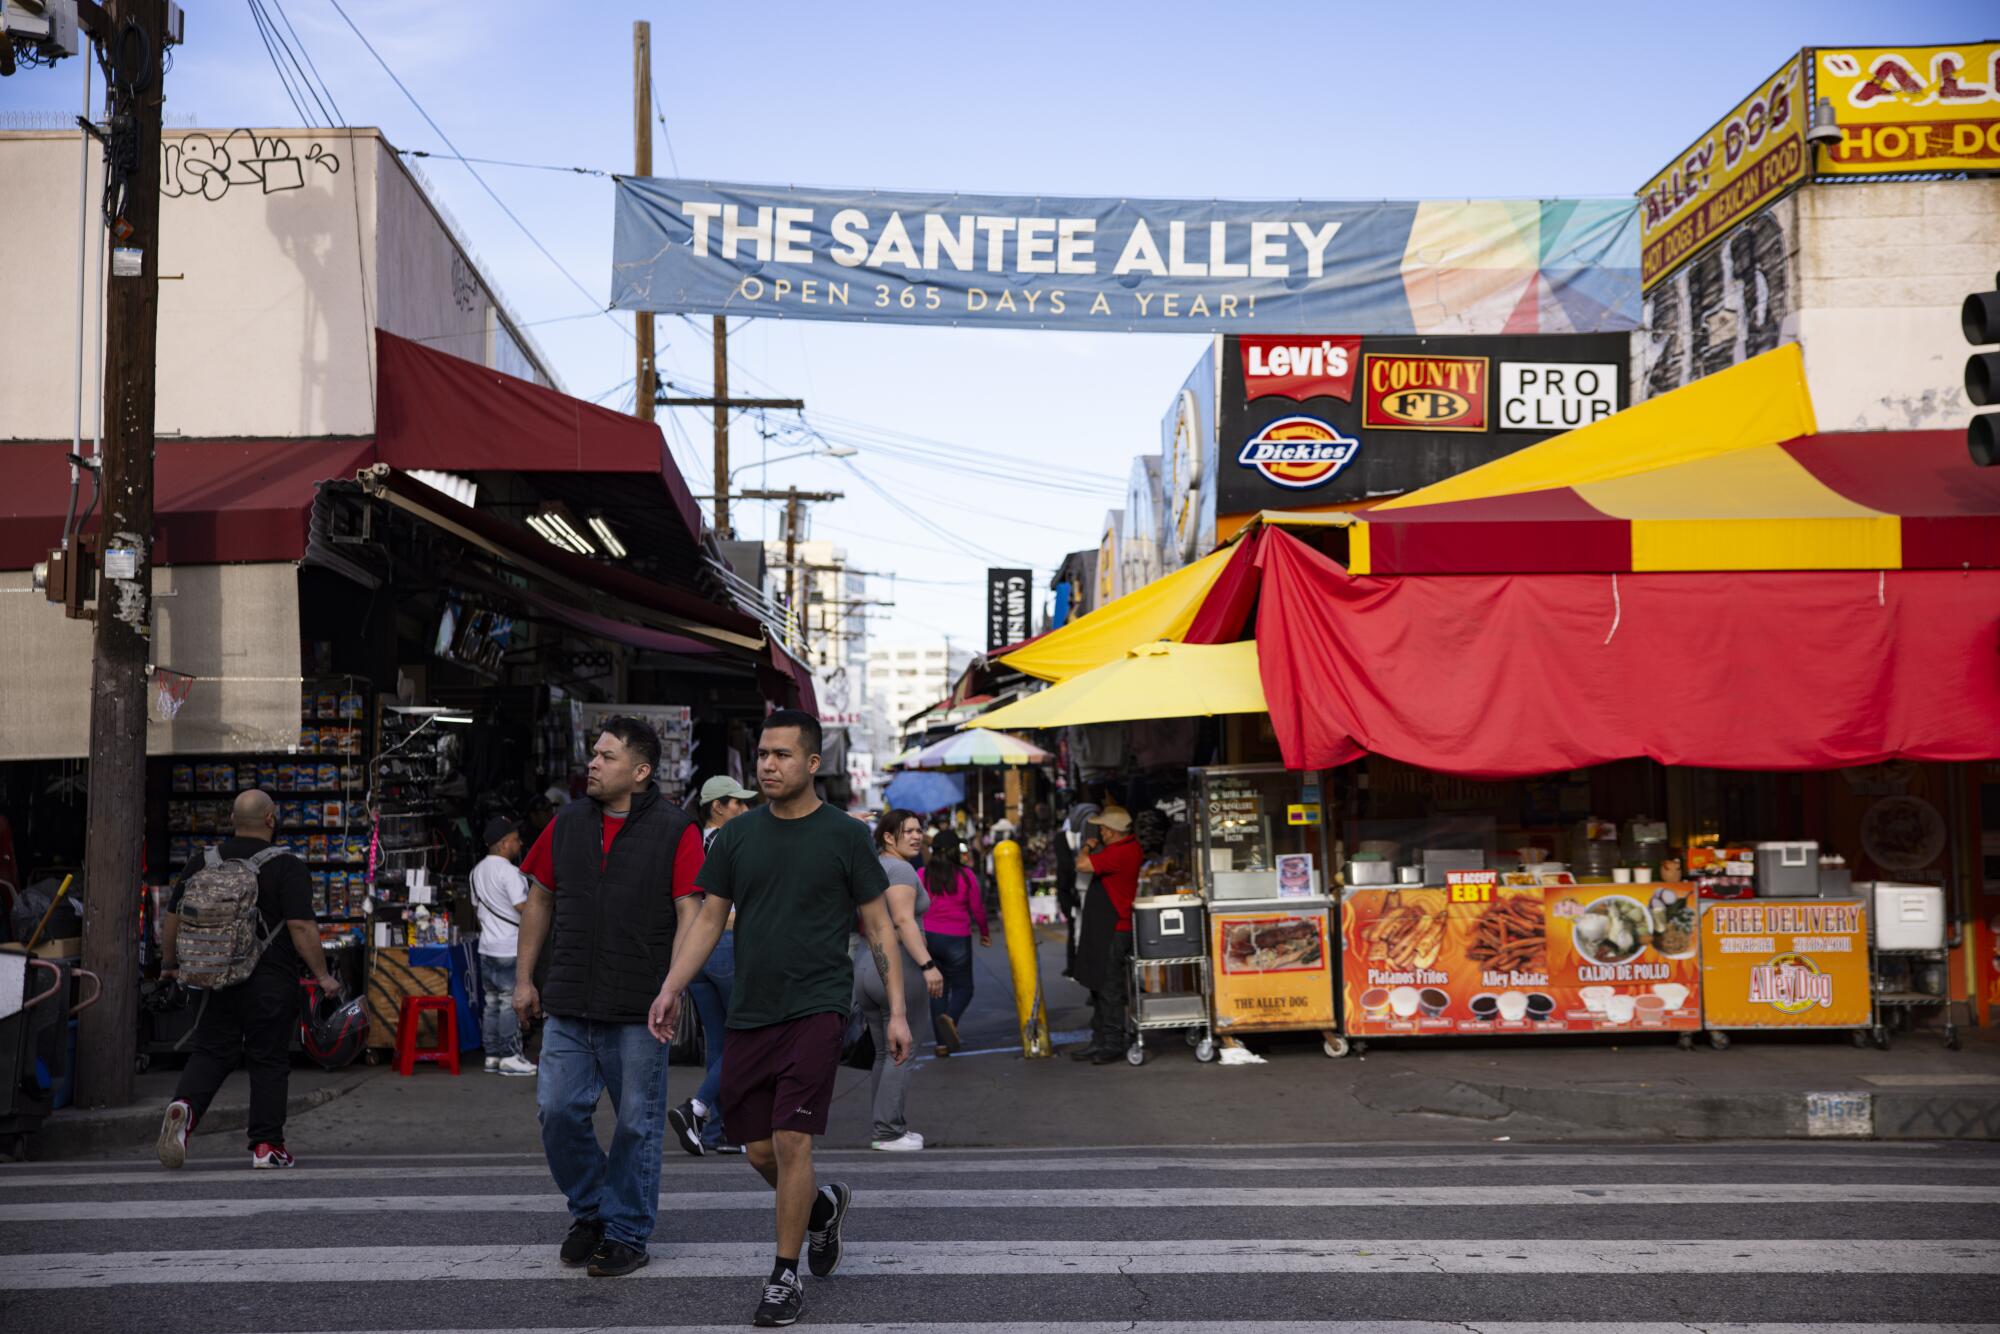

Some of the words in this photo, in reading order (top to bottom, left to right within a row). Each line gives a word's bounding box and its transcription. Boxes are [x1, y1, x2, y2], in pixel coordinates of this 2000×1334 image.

[1823, 50, 2000, 108] "AL
[1839, 126, 1932, 159] HOT
[1643, 242, 1664, 279] HOT
[1665, 219, 1694, 258] DOGS
[1708, 172, 1761, 231] MEXICAN
[1764, 141, 1799, 188] FOOD
[682, 202, 814, 264] THE
[830, 209, 1096, 274] SANTEE
[1112, 218, 1343, 278] ALLEY
[740, 277, 850, 306] OPEN
[874, 284, 942, 310] 365
[967, 288, 1067, 315] DAYS
[1089, 292, 1112, 316] A
[1135, 293, 1257, 318] YEAR!
[1371, 360, 1482, 394] COUNTY
[1519, 369, 1600, 396] PRO
[1394, 393, 1460, 419] FB
[1505, 398, 1612, 425] CLUB
[1253, 443, 1347, 461] Dickies
[1447, 872, 1462, 884] WE
[1463, 871, 1497, 883] ACCEPT
[1451, 884, 1493, 902] EBT
[1712, 906, 1763, 934] FREE
[1765, 905, 1861, 934] DELIVERY
[1368, 969, 1414, 985] Platanos
[1416, 969, 1449, 985] Fritos
[1482, 970, 1509, 988] Alley
[1578, 965, 1615, 982] CALDO
[1617, 965, 1633, 981] DE
[1634, 963, 1670, 980] POLLO
[1234, 998, 1254, 1009] THE
[1256, 996, 1286, 1009] ALLEY
[1289, 996, 1309, 1008] DOG
